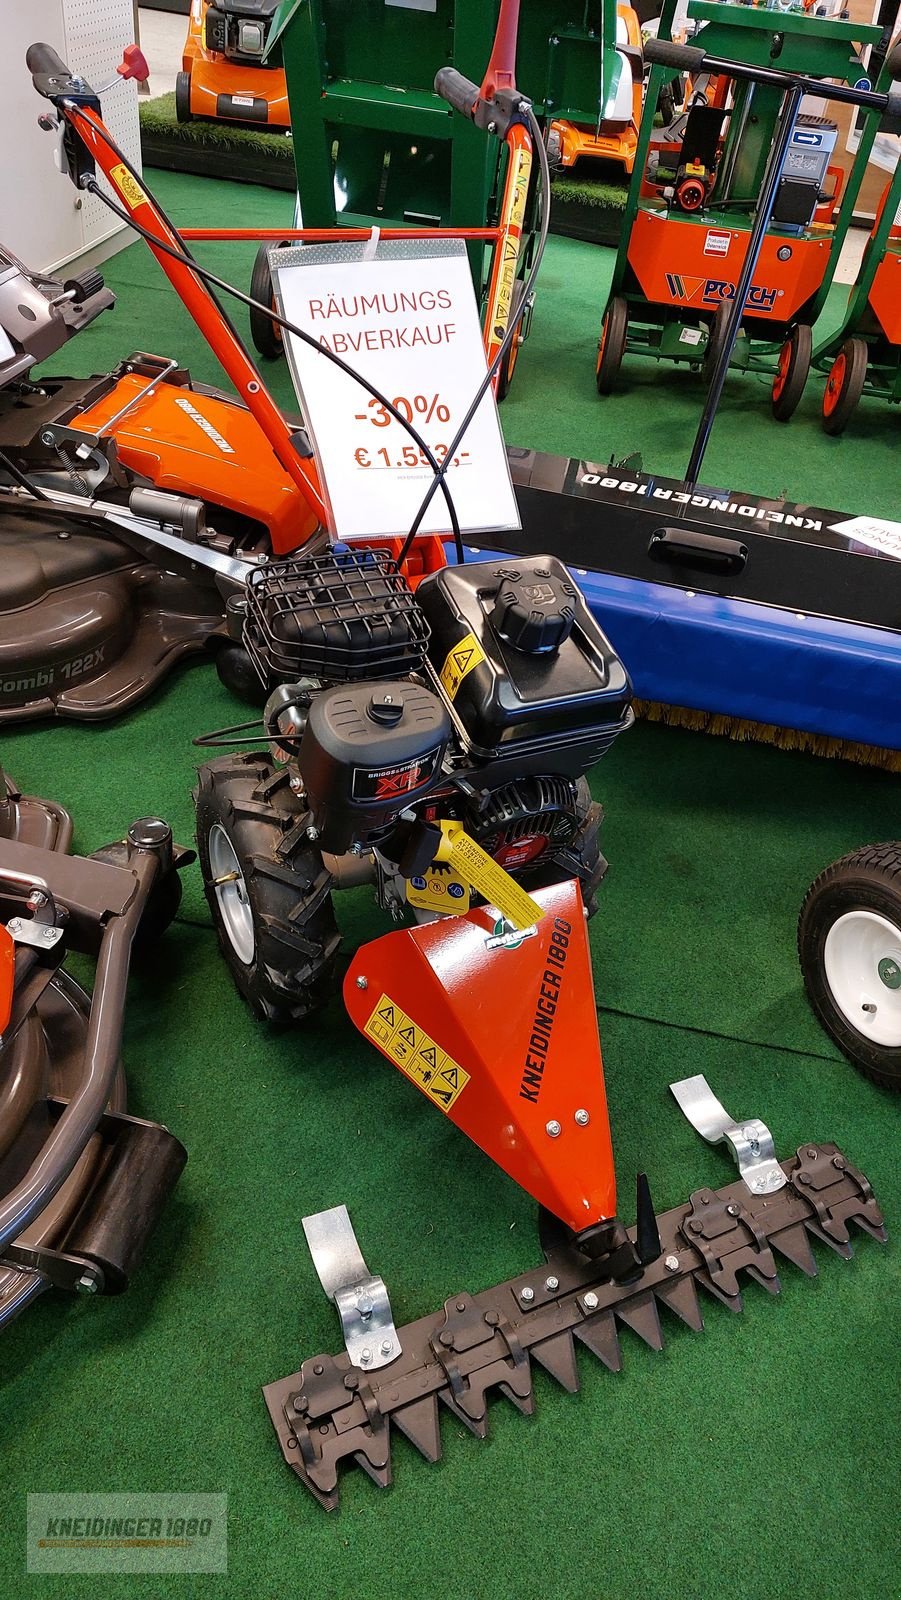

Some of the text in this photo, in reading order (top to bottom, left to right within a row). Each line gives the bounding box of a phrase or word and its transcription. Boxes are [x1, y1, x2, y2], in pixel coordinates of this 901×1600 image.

[309, 289, 452, 320] RÄUMUNGS
[317, 323, 456, 354] ABVERKAUF
[354, 393, 451, 427] -30%
[354, 447, 371, 467] €
[581, 473, 823, 531] KNEIDINGER 1880
[0, 645, 105, 692] ombi 122X
[375, 768, 421, 794] XR
[519, 917, 572, 1104] KNEIDINGER 1880
